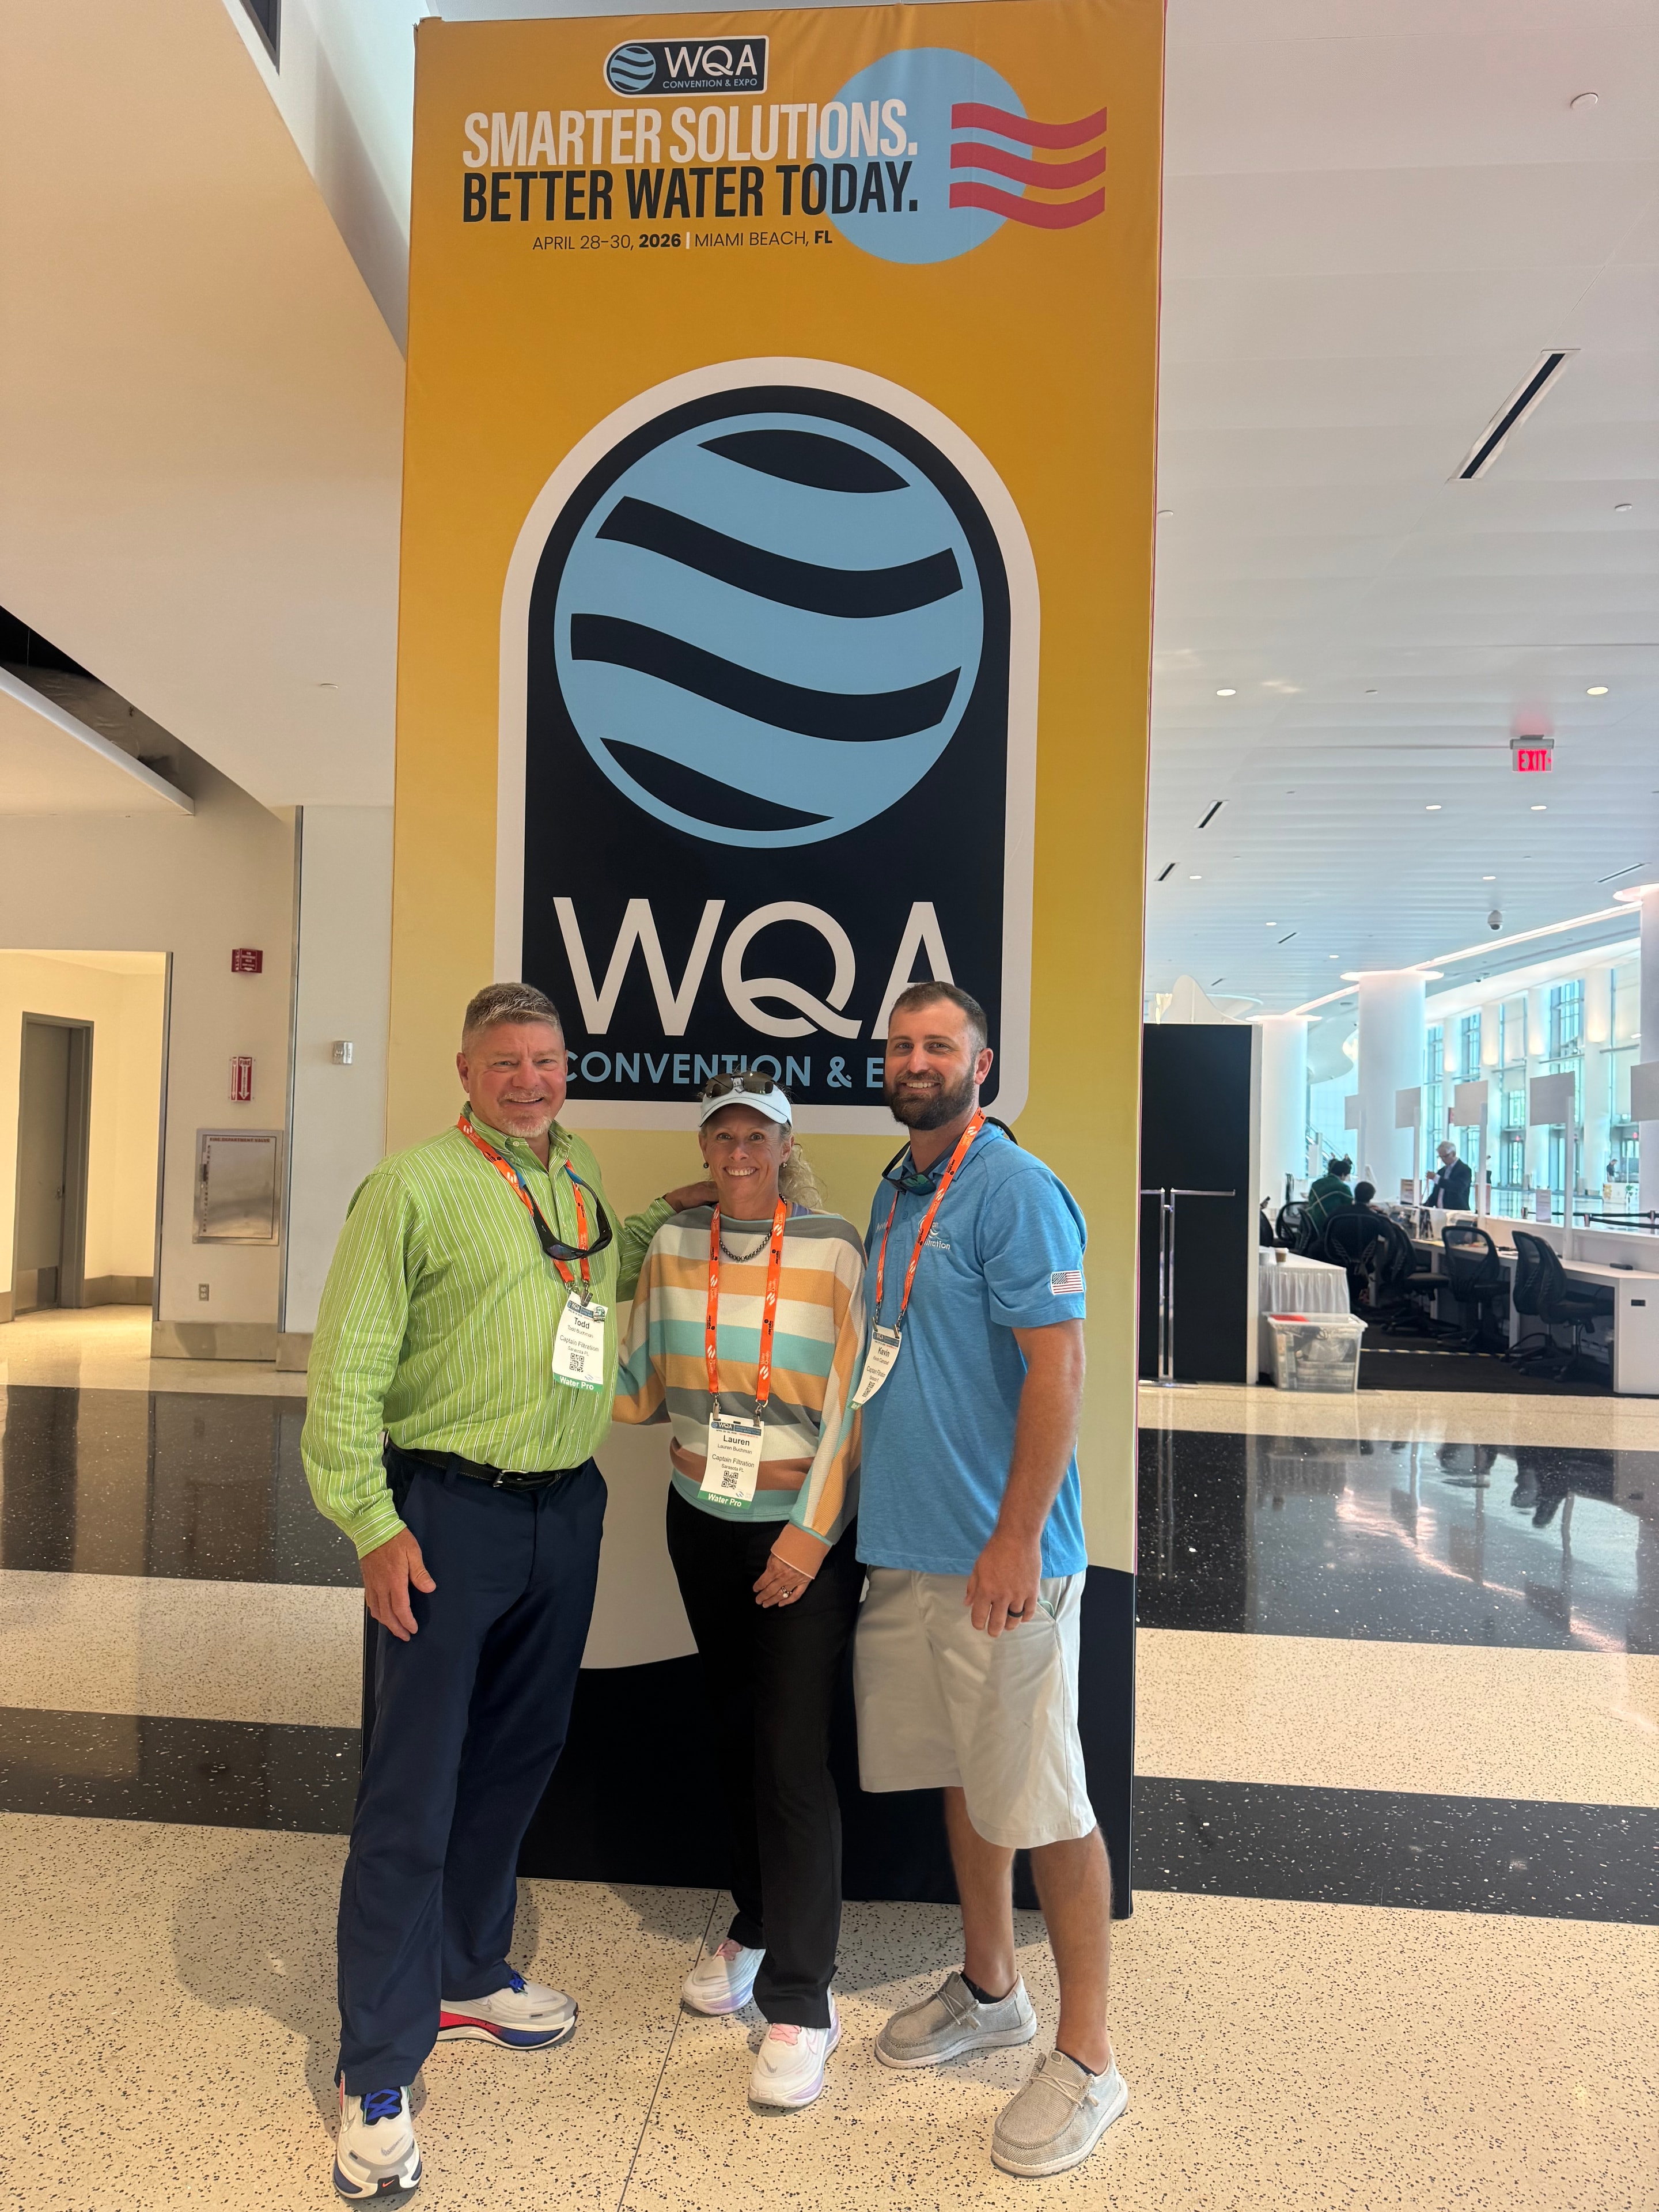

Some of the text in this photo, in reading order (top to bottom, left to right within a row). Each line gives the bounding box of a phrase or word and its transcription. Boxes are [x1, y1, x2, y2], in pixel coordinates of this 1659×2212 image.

[664, 44, 757, 78] WQA
[663, 79, 722, 88] CONVENTION
[463, 98, 918, 168] SMARTER SOLUTIONS.
[463, 161, 918, 222] BETTER WATER TODAY.
[532, 236, 575, 250] APRIL
[639, 233, 681, 248] 2026
[695, 233, 744, 247] MIAMI
[749, 231, 809, 248] BEACH,
[815, 230, 832, 244] FL
[1518, 749, 1547, 772] EXIT
[552, 896, 956, 1040] WQA
[826, 1056, 853, 1088] &
[924, 1238, 950, 1250] iltration
[574, 1317, 590, 1329] Todd
[560, 1335, 577, 1346] Captain
[877, 1346, 890, 1357] Kevin
[560, 1376, 594, 1390] Water Pro
[724, 1434, 750, 1446] Lauren
[712, 1454, 755, 1468] Captain Filtration
[708, 1493, 742, 1507] Water Pro
